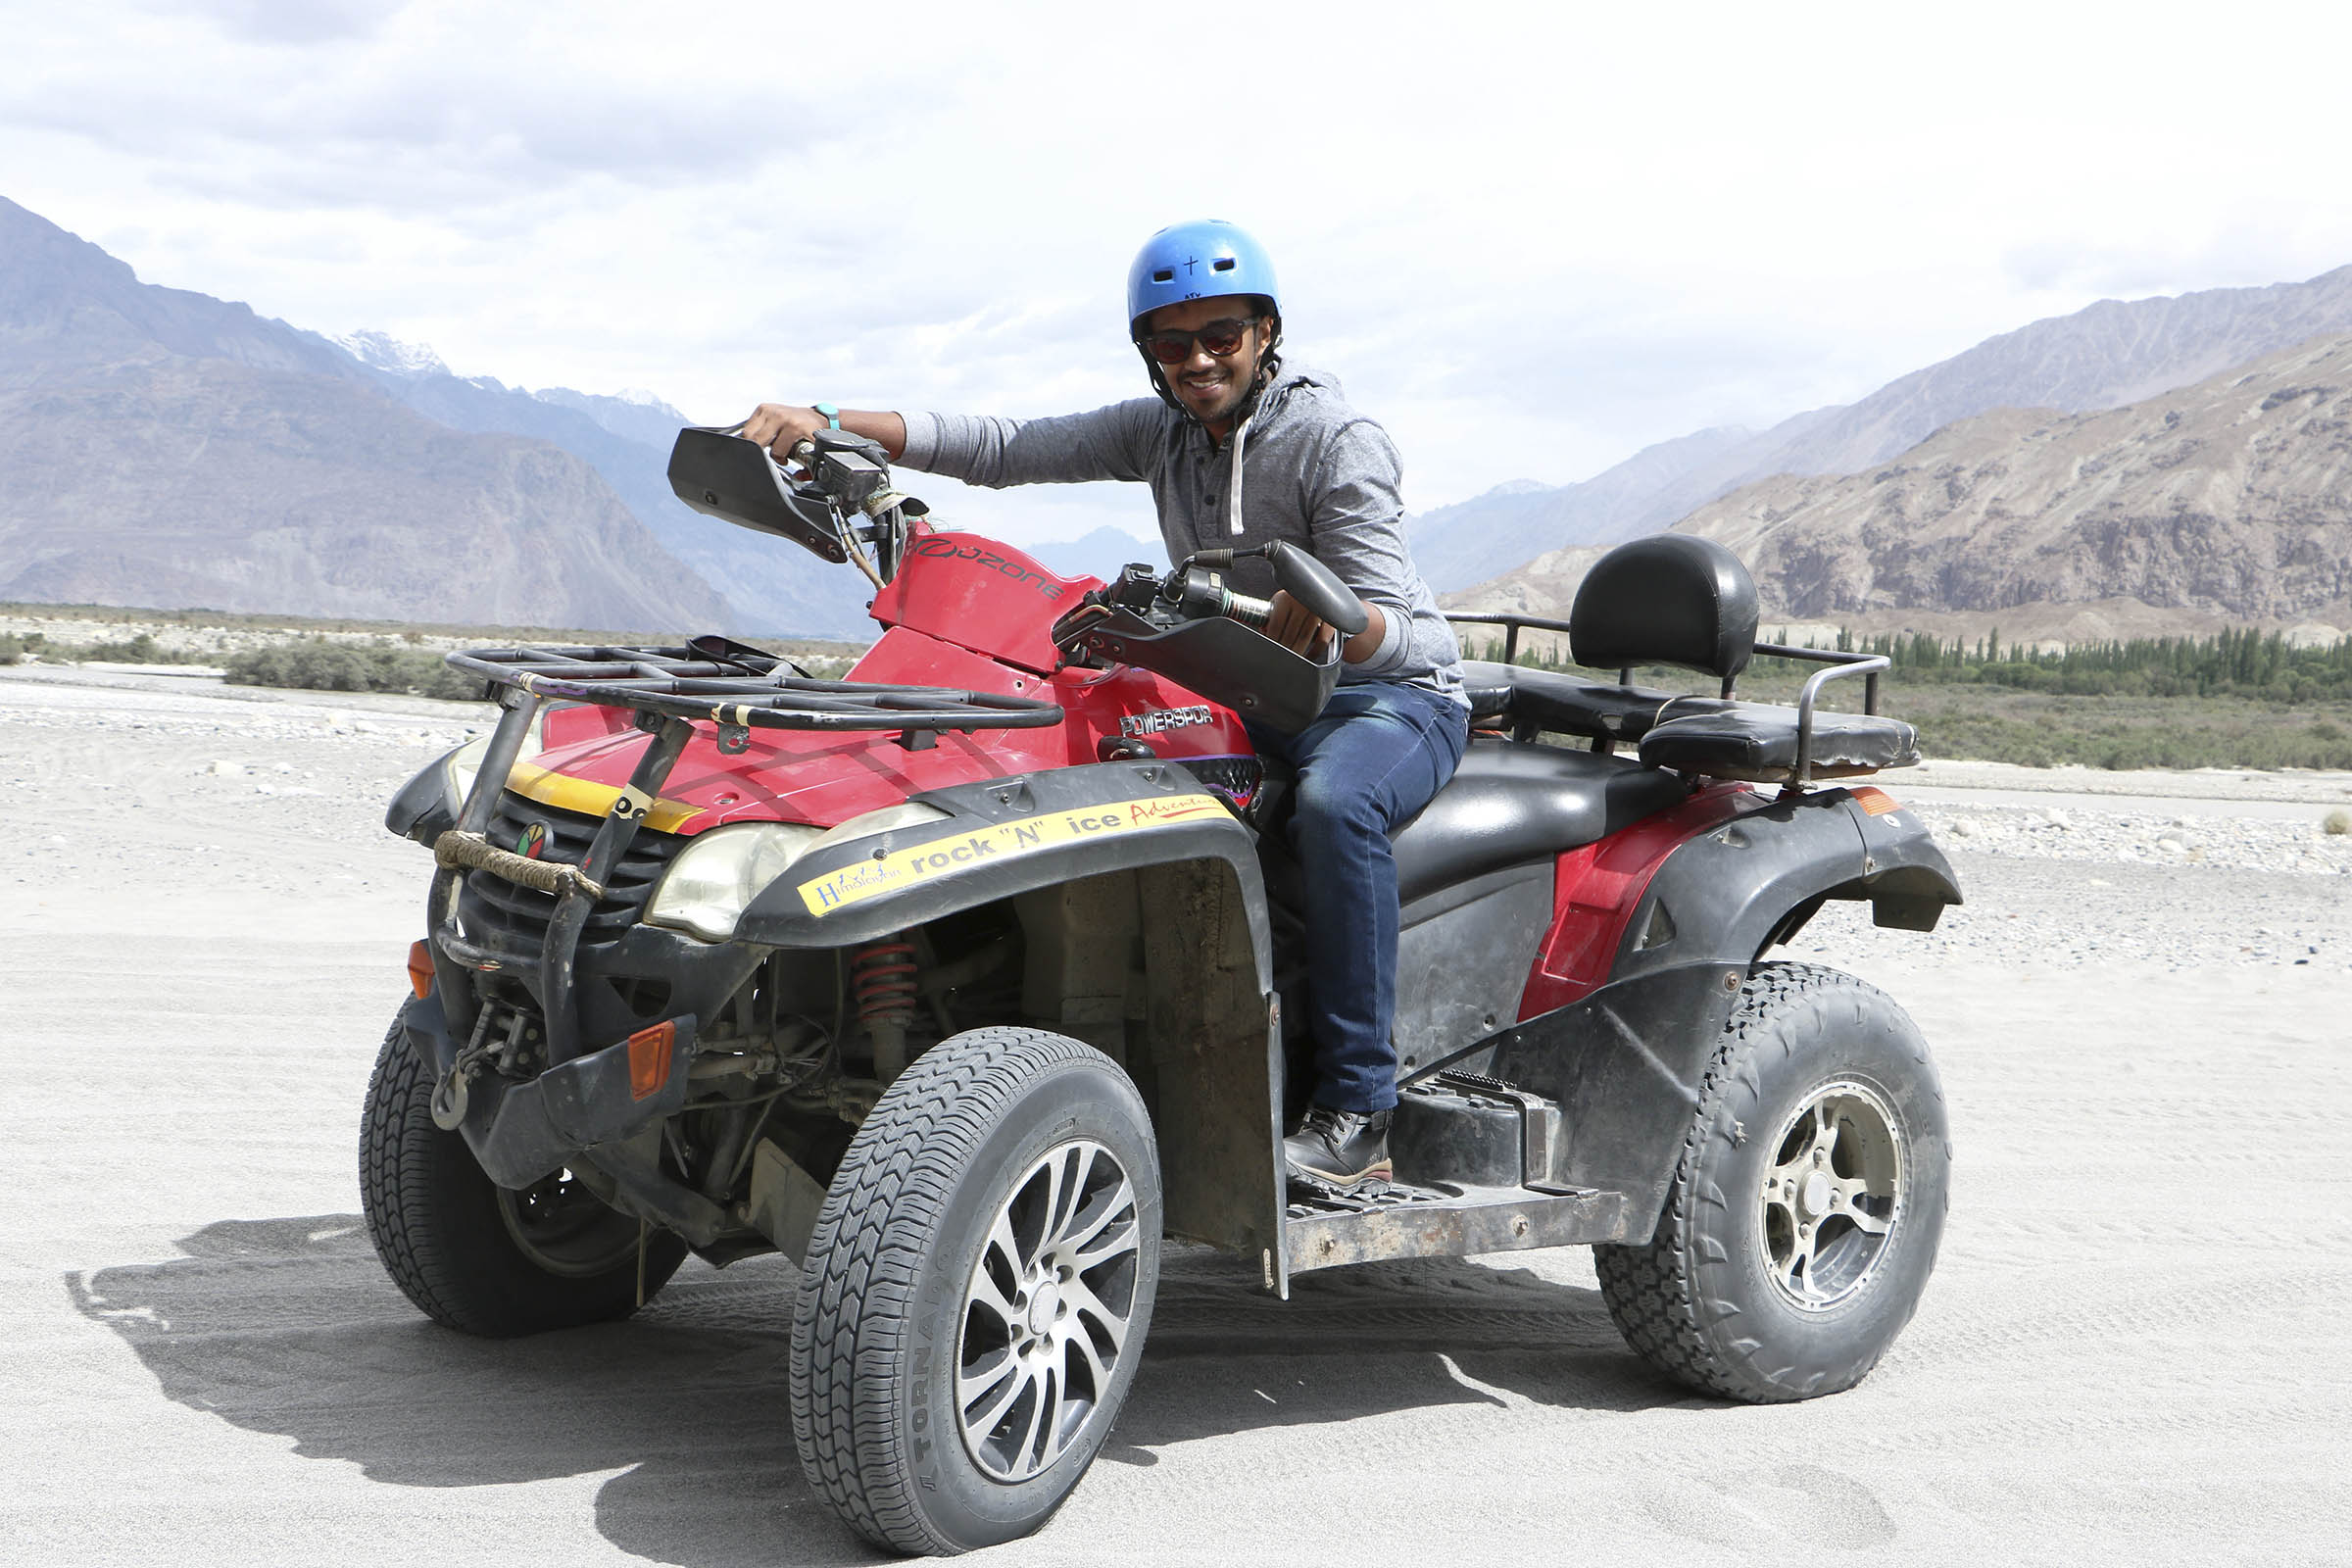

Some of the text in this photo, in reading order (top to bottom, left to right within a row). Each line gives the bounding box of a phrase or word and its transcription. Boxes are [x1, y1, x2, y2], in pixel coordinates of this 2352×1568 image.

[956, 546, 1065, 601] OZONE
[1119, 705, 1213, 738] POWERSPOR
[910, 838, 996, 874] rock
[999, 820, 1044, 849] "N"
[1066, 814, 1121, 834] ice
